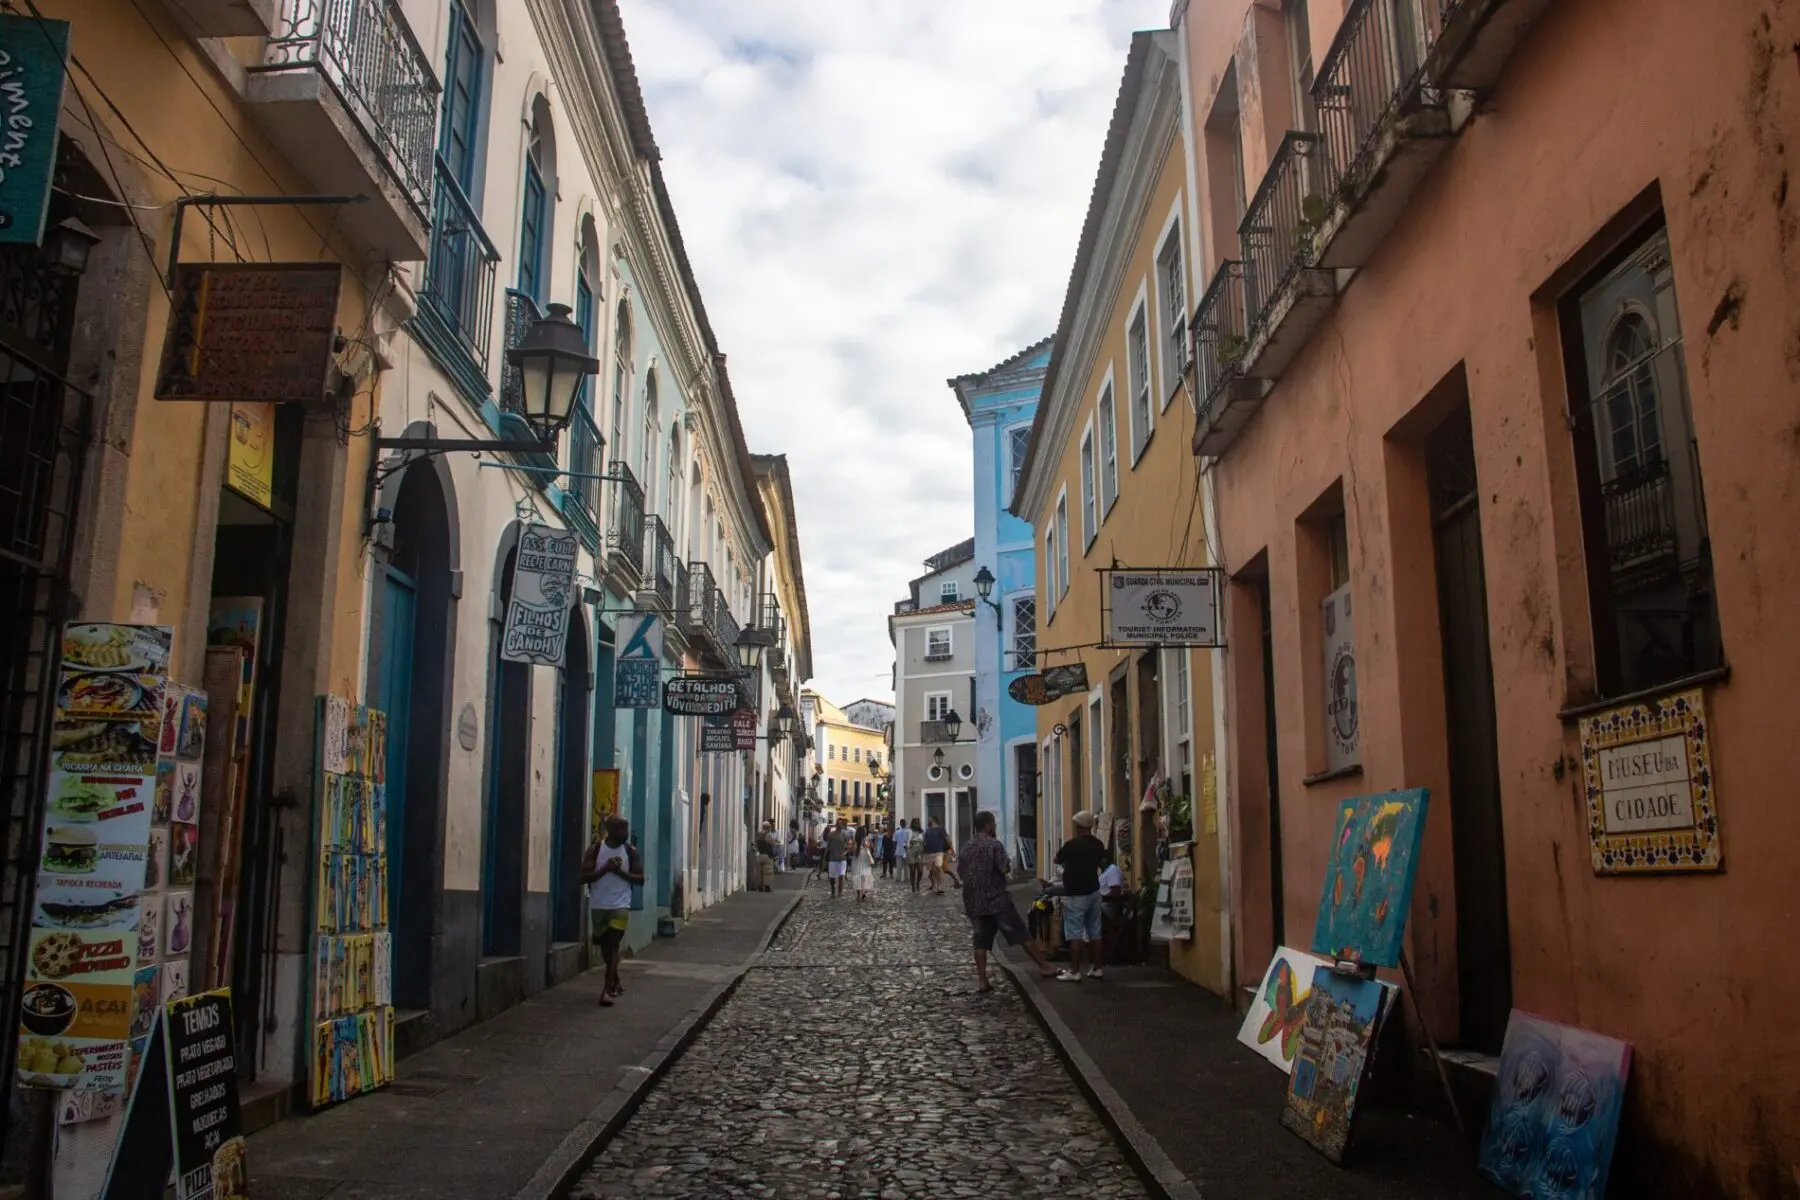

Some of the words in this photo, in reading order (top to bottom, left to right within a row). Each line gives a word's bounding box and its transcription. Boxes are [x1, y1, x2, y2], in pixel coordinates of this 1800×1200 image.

[1126, 577, 1148, 586] GUARDA
[1166, 578, 1196, 587] MUNICIPAL
[515, 606, 561, 631] FILHOS
[507, 630, 563, 657] GANDHY
[527, 627, 545, 638] DE
[668, 682, 736, 694] RETALHOS
[706, 698, 738, 714] EDITH
[1608, 751, 1664, 780] MUSEU
[1665, 755, 1680, 771] DA
[183, 1002, 220, 1036] TEMOS
[180, 1043, 202, 1063] PRATO
[176, 1068, 197, 1090] PRATO
[190, 1082, 227, 1110] GRELHADOS
